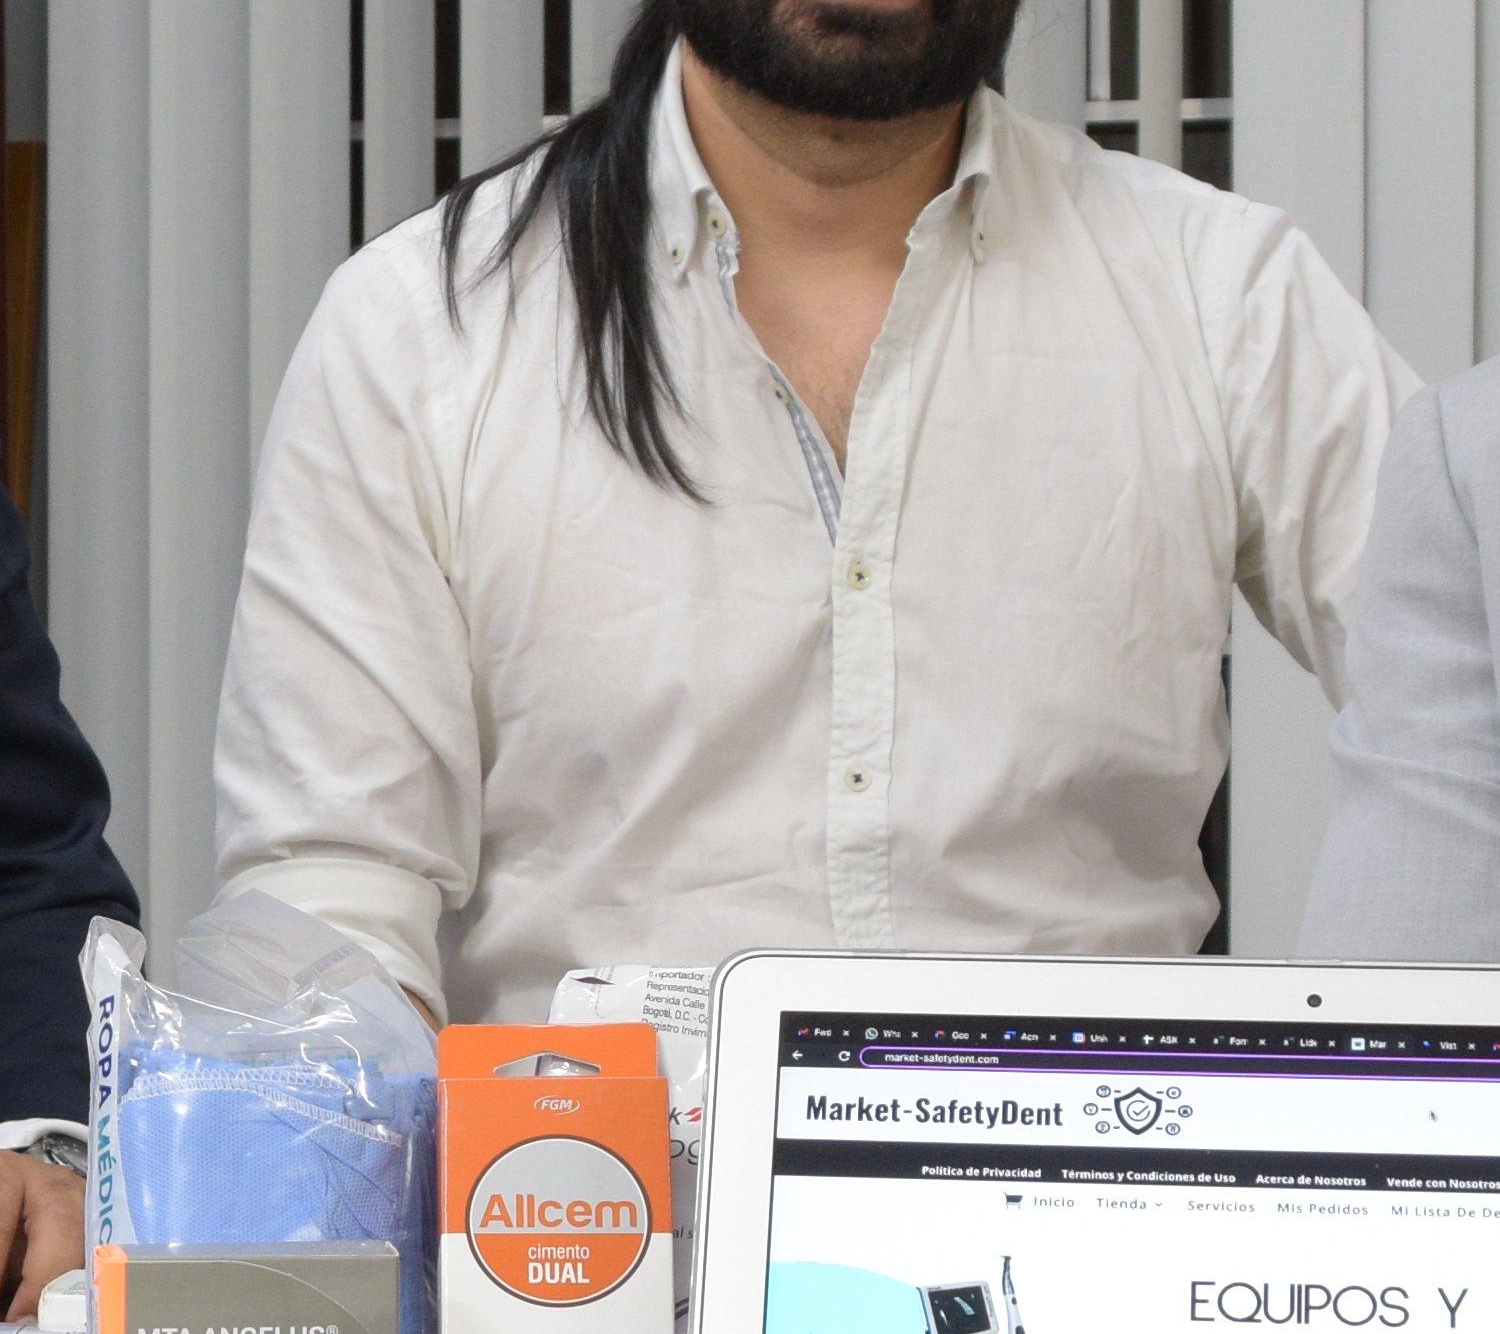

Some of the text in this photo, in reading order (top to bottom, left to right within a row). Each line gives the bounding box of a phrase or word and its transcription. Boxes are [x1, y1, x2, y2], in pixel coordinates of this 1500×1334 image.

[96, 993, 116, 1107] ROPA
[884, 1053, 999, 1064] market-safetydent.com
[541, 1099, 572, 1111] FGM
[806, 1095, 1062, 1128] Market-SafetyDent
[921, 1165, 963, 1175] Política
[965, 1166, 979, 1176] de
[982, 1167, 1041, 1177] Privacidad
[1061, 1169, 1114, 1179] Términos
[1117, 1172, 1124, 1182] y
[1126, 1171, 1194, 1181] Condiciones
[1197, 1172, 1211, 1182] de
[1214, 1173, 1236, 1182] Uso
[1255, 1174, 1294, 1184] Acerca
[1297, 1175, 1311, 1184] de
[1314, 1176, 1366, 1186] Nosotros
[1387, 1177, 1422, 1187] Vende
[1425, 1180, 1446, 1188] con
[1449, 1179, 1500, 1189] Nosotros
[479, 1194, 638, 1228] Allcem
[1034, 1196, 1074, 1207] Inicio
[1096, 1197, 1146, 1209] Tienda
[1188, 1200, 1254, 1212] Servicios
[1277, 1202, 1302, 1213] Mis
[1309, 1203, 1368, 1215] Pedidos
[1391, 1205, 1408, 1215] Mi
[1415, 1206, 1450, 1217] Lista
[1457, 1207, 1476, 1217] De
[528, 1244, 590, 1260] cimento
[528, 1263, 590, 1284] DUAL
[1190, 1281, 1468, 1328] EQUIPOS Y
